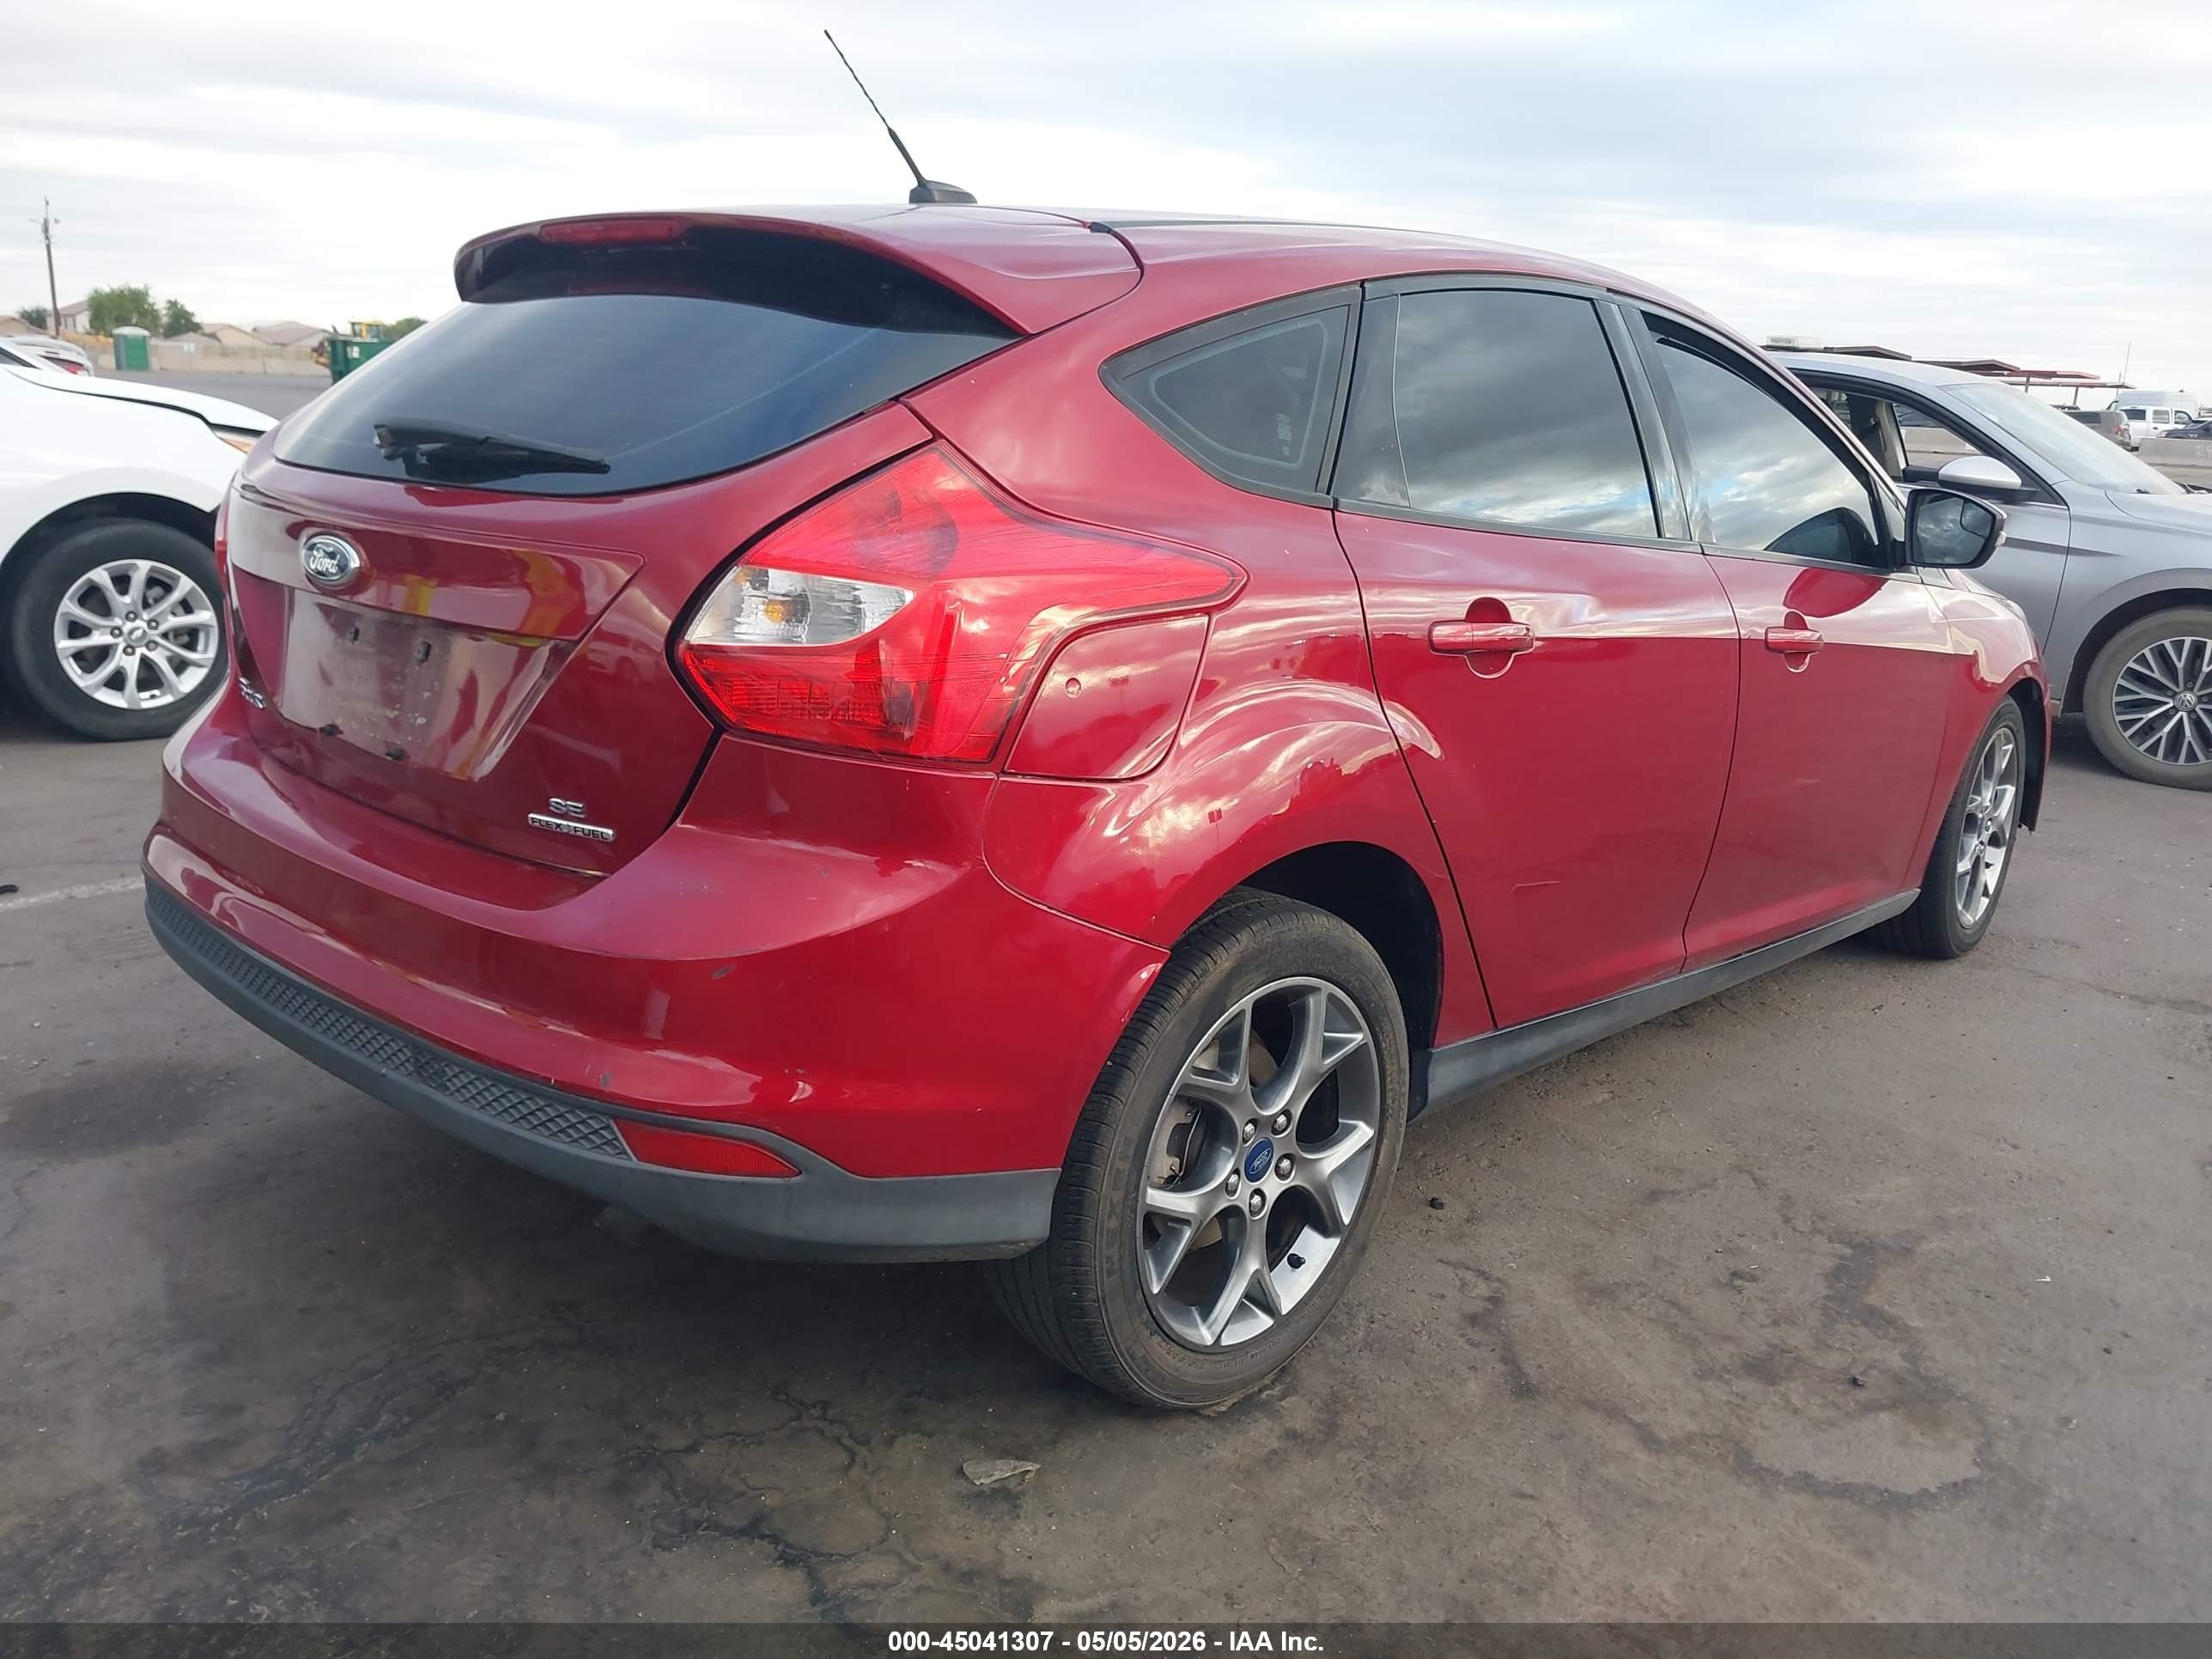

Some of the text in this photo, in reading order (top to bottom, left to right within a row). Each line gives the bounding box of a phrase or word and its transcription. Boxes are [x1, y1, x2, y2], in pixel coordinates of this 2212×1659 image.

[310, 544, 340, 574] Ford
[549, 797, 586, 817] SE
[531, 817, 610, 841] FLEX FUEL
